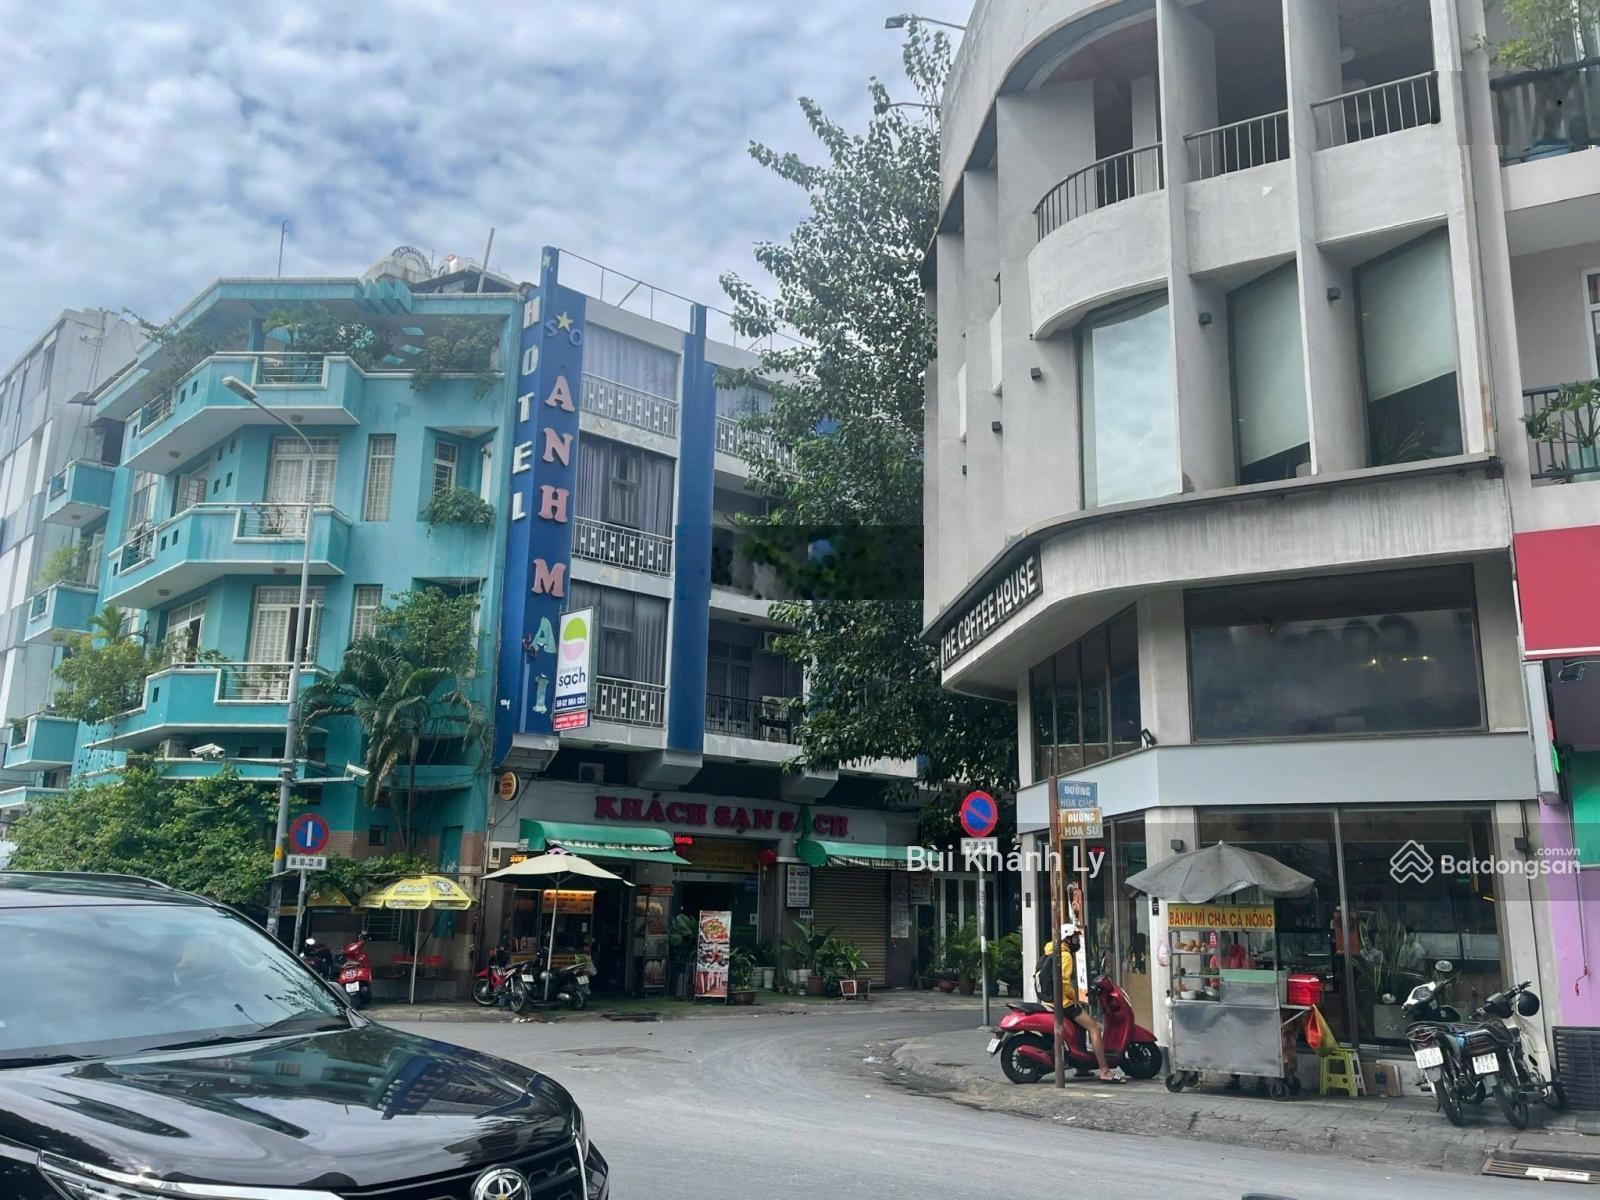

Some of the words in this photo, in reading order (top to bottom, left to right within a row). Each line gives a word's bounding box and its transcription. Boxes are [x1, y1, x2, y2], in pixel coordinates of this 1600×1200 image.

[511, 294, 541, 522] HOTEL
[941, 626, 957, 664] THE
[957, 592, 996, 650] COFFEE
[995, 556, 1036, 619] HOUSE
[558, 665, 586, 688] sạch
[594, 793, 708, 826] KHÁCH
[714, 805, 773, 835] SẠN
[1064, 826, 1083, 837] HOA
[1169, 907, 1193, 925] BÁNH
[1195, 908, 1205, 925] MÌ
[1245, 908, 1273, 928] NÓNG
